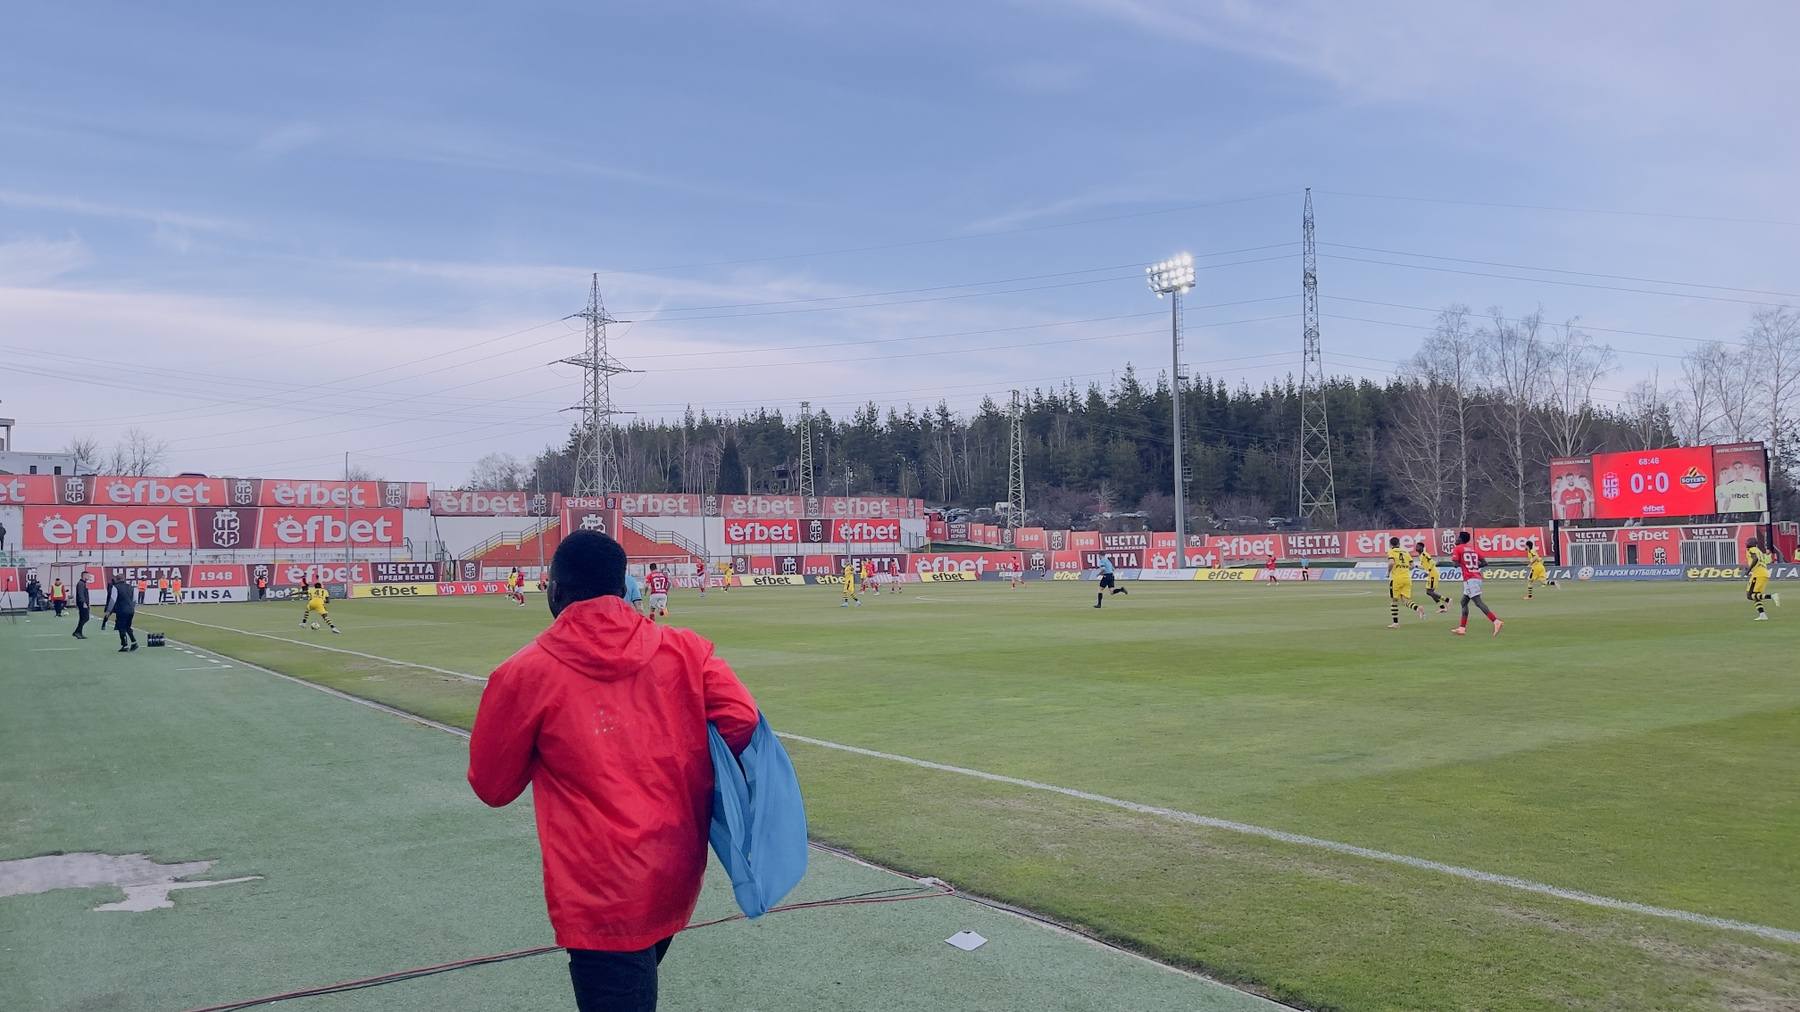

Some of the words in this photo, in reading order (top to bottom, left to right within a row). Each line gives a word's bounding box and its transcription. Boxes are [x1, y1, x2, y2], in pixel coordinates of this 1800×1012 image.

[108, 479, 210, 504] efbet
[275, 483, 365, 505] efbet
[440, 492, 520, 513] efbet
[566, 498, 602, 508] efbet
[622, 494, 689, 513] efbet
[732, 496, 794, 514] efbet
[833, 498, 890, 515] efbet
[43, 514, 178, 544] efbet
[277, 515, 393, 543] efbet
[729, 522, 794, 541] efbet
[840, 522, 898, 540] efbet
[1692, 528, 1729, 536] ЧЕСТТА
[1104, 535, 1147, 546] ЧЕСТТА
[1288, 535, 1340, 547] ЧЕСТТА
[1628, 530, 1669, 541] efbet
[1219, 536, 1274, 556] efbet
[1479, 534, 1540, 551] efbet
[917, 555, 989, 575] efbet
[1055, 561, 1078, 569] 1948
[1463, 552, 1479, 569] 93
[113, 567, 182, 580] ЧЕСТТА
[287, 564, 363, 583] efbet
[377, 563, 435, 575] ЧЕСТТА
[806, 566, 829, 574] 1948
[1207, 569, 1244, 580] efbet
[1484, 569, 1527, 579] efbet
[1687, 567, 1742, 578] efbet
[200, 571, 233, 581] 1948
[753, 576, 791, 585] efbet
[816, 575, 846, 584] efbe
[932, 572, 964, 581] efbet
[440, 583, 455, 594] vip
[461, 583, 477, 593] vip
[482, 582, 498, 592] vip
[653, 577, 666, 589] 67
[370, 586, 418, 596] efbet
